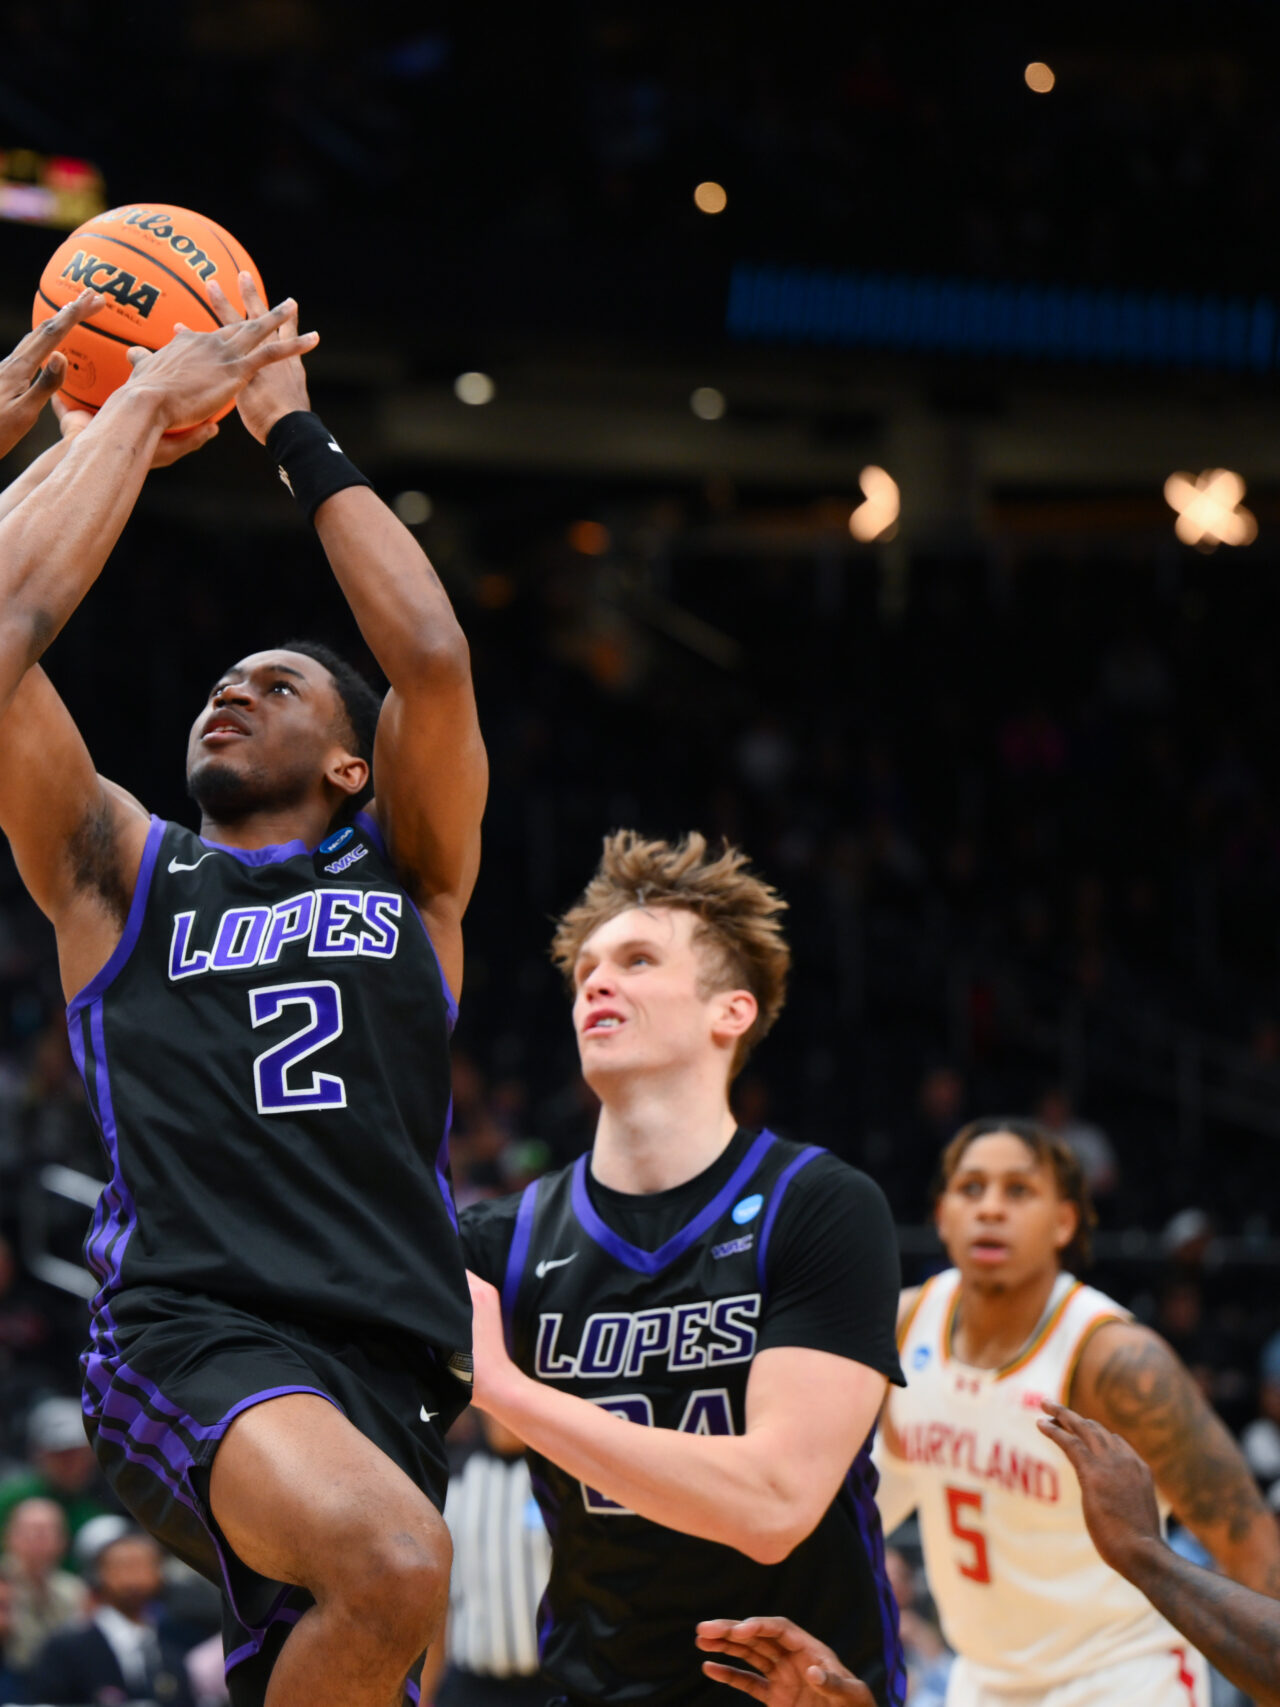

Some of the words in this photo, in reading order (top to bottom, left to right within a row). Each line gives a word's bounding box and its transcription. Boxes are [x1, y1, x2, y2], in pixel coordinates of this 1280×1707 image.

[60, 250, 161, 319] NCAA
[324, 843, 368, 875] WAC
[327, 829, 353, 852] NCAA
[168, 888, 402, 981] LOPES
[248, 980, 347, 1114] 2
[711, 1233, 754, 1260] WAC
[535, 1293, 762, 1379] LOPES
[944, 1484, 992, 1585] 5
